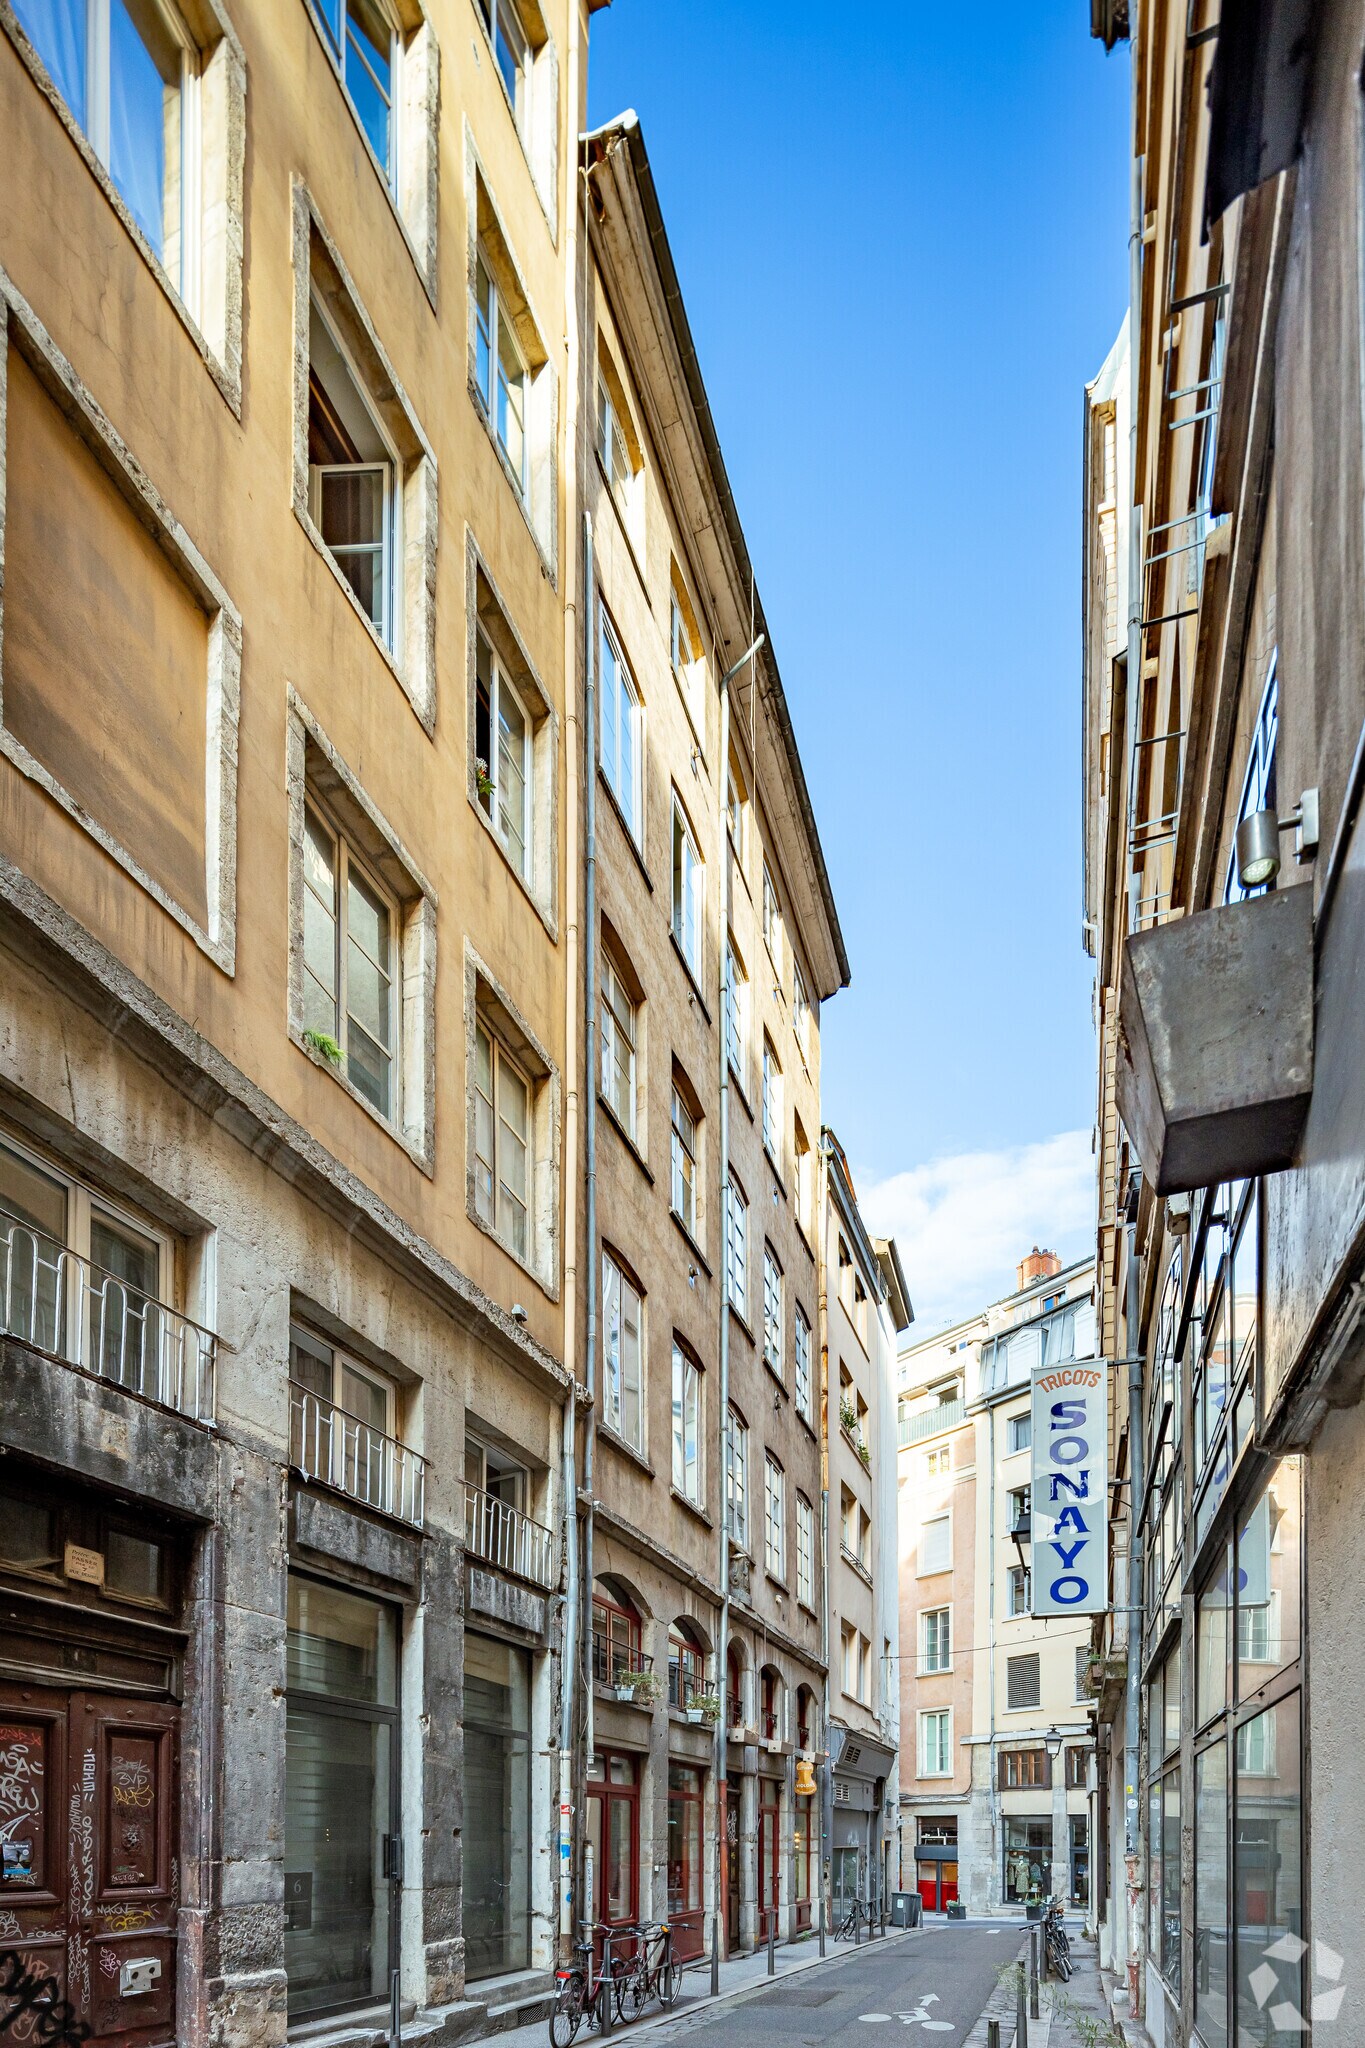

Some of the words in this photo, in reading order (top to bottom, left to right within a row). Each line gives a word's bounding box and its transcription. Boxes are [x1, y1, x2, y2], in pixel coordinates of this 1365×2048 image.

[1035, 1368, 1102, 1393] TRICOTS
[1048, 1399, 1091, 1604] SONAYO
[294, 1879, 302, 1894] 6
